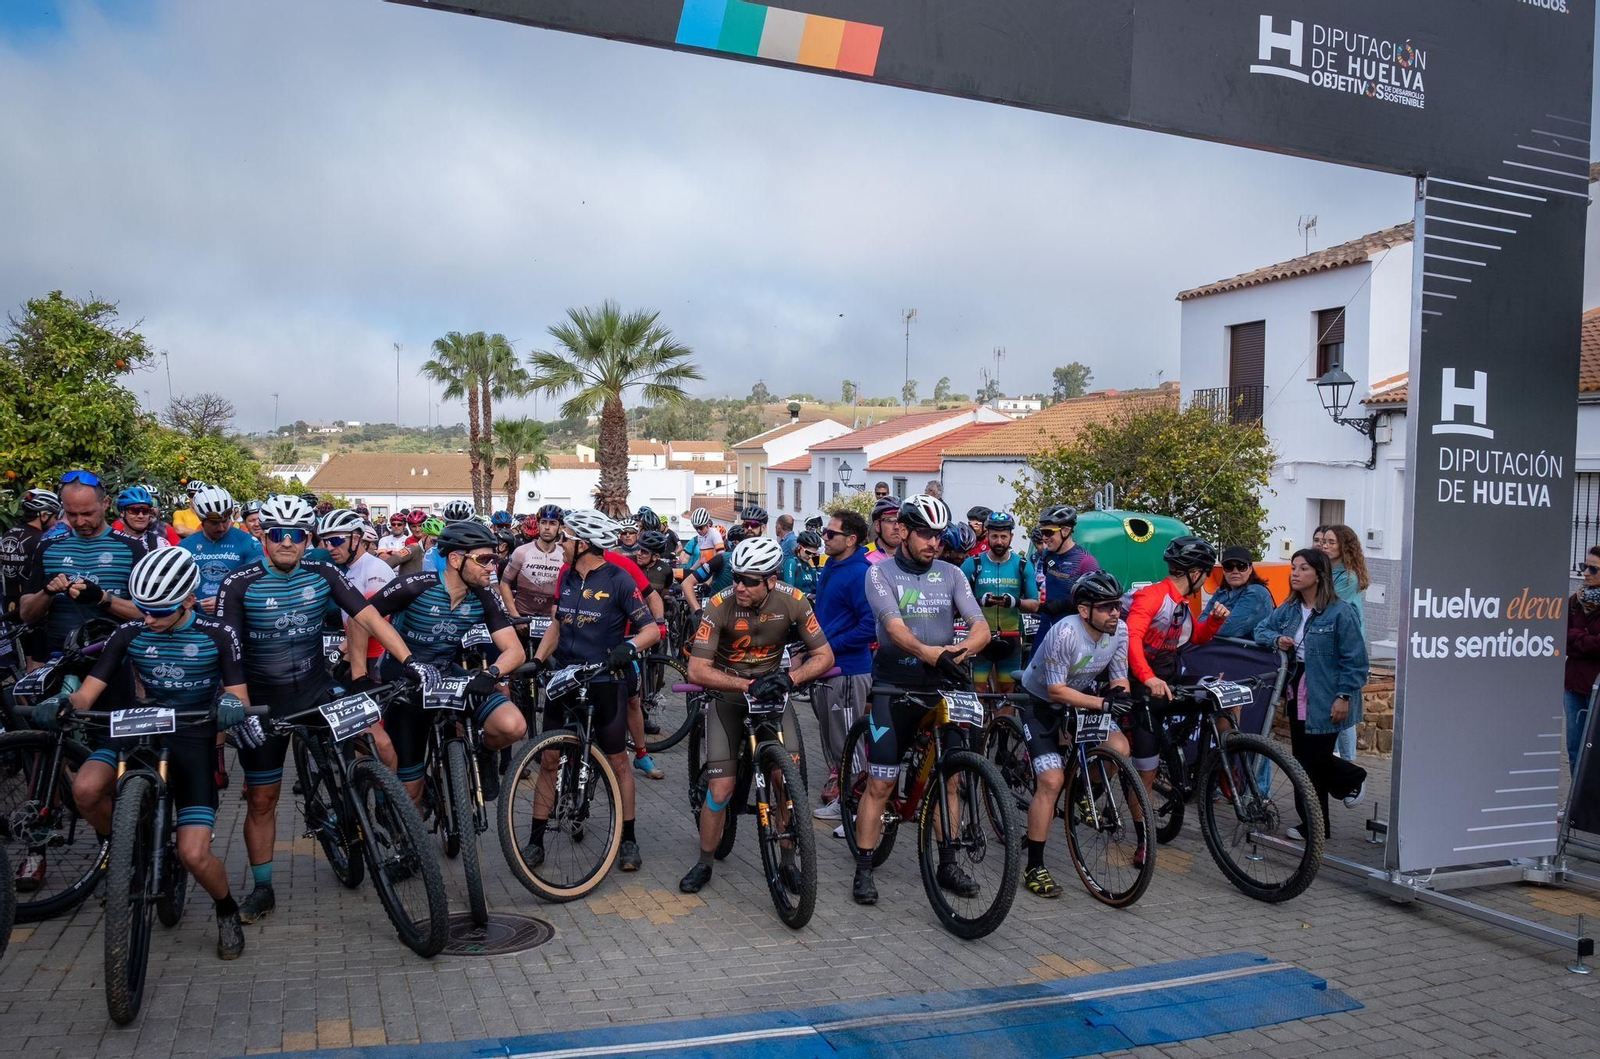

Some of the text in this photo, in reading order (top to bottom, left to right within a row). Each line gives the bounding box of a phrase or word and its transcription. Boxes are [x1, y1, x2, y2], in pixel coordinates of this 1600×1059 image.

[1312, 24, 1426, 70] DIPUTACIÓN
[1311, 48, 1424, 92] DE HUELVA
[1311, 70, 1386, 100] OBJETIVOS
[1384, 92, 1425, 109] SOSTENIBLE
[1439, 446, 1563, 478] DIPUTACIÓN
[1438, 479, 1551, 507] DE HUELVA
[224, 566, 261, 587] Store
[720, 587, 735, 599] Mar
[1412, 587, 1563, 620] Huelva eleva
[288, 623, 322, 636] Stor
[1410, 628, 1560, 659] tus sentidos.
[164, 678, 211, 689] Store
[337, 703, 364, 717] 1270
[1084, 714, 1102, 725] 1031
